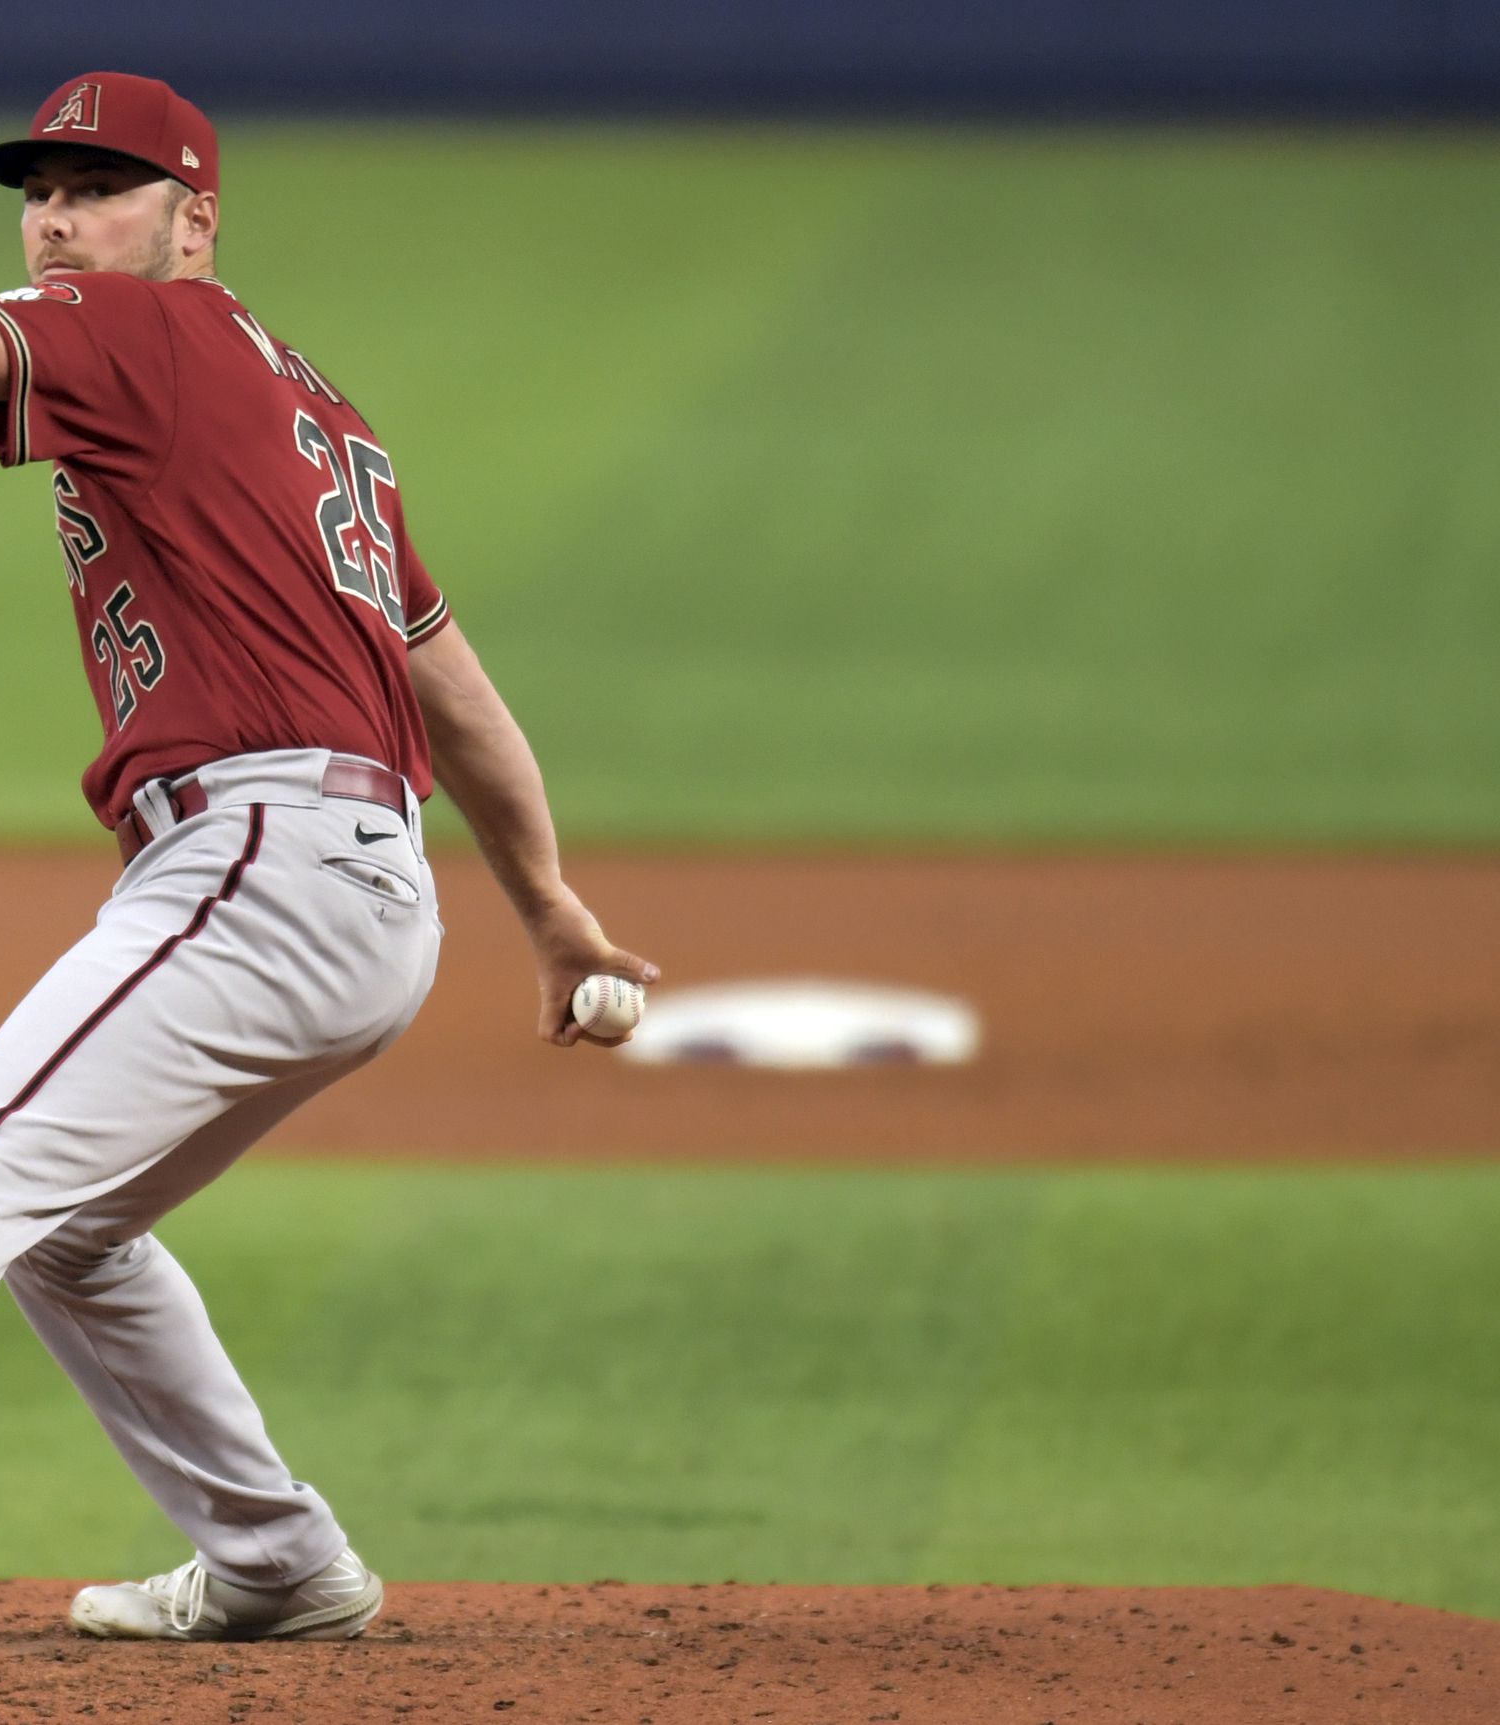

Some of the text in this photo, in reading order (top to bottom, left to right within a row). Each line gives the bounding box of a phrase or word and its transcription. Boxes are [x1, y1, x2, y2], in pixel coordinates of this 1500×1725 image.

[52, 467, 108, 597] S
[293, 408, 408, 642] 25
[92, 580, 166, 732] 25
